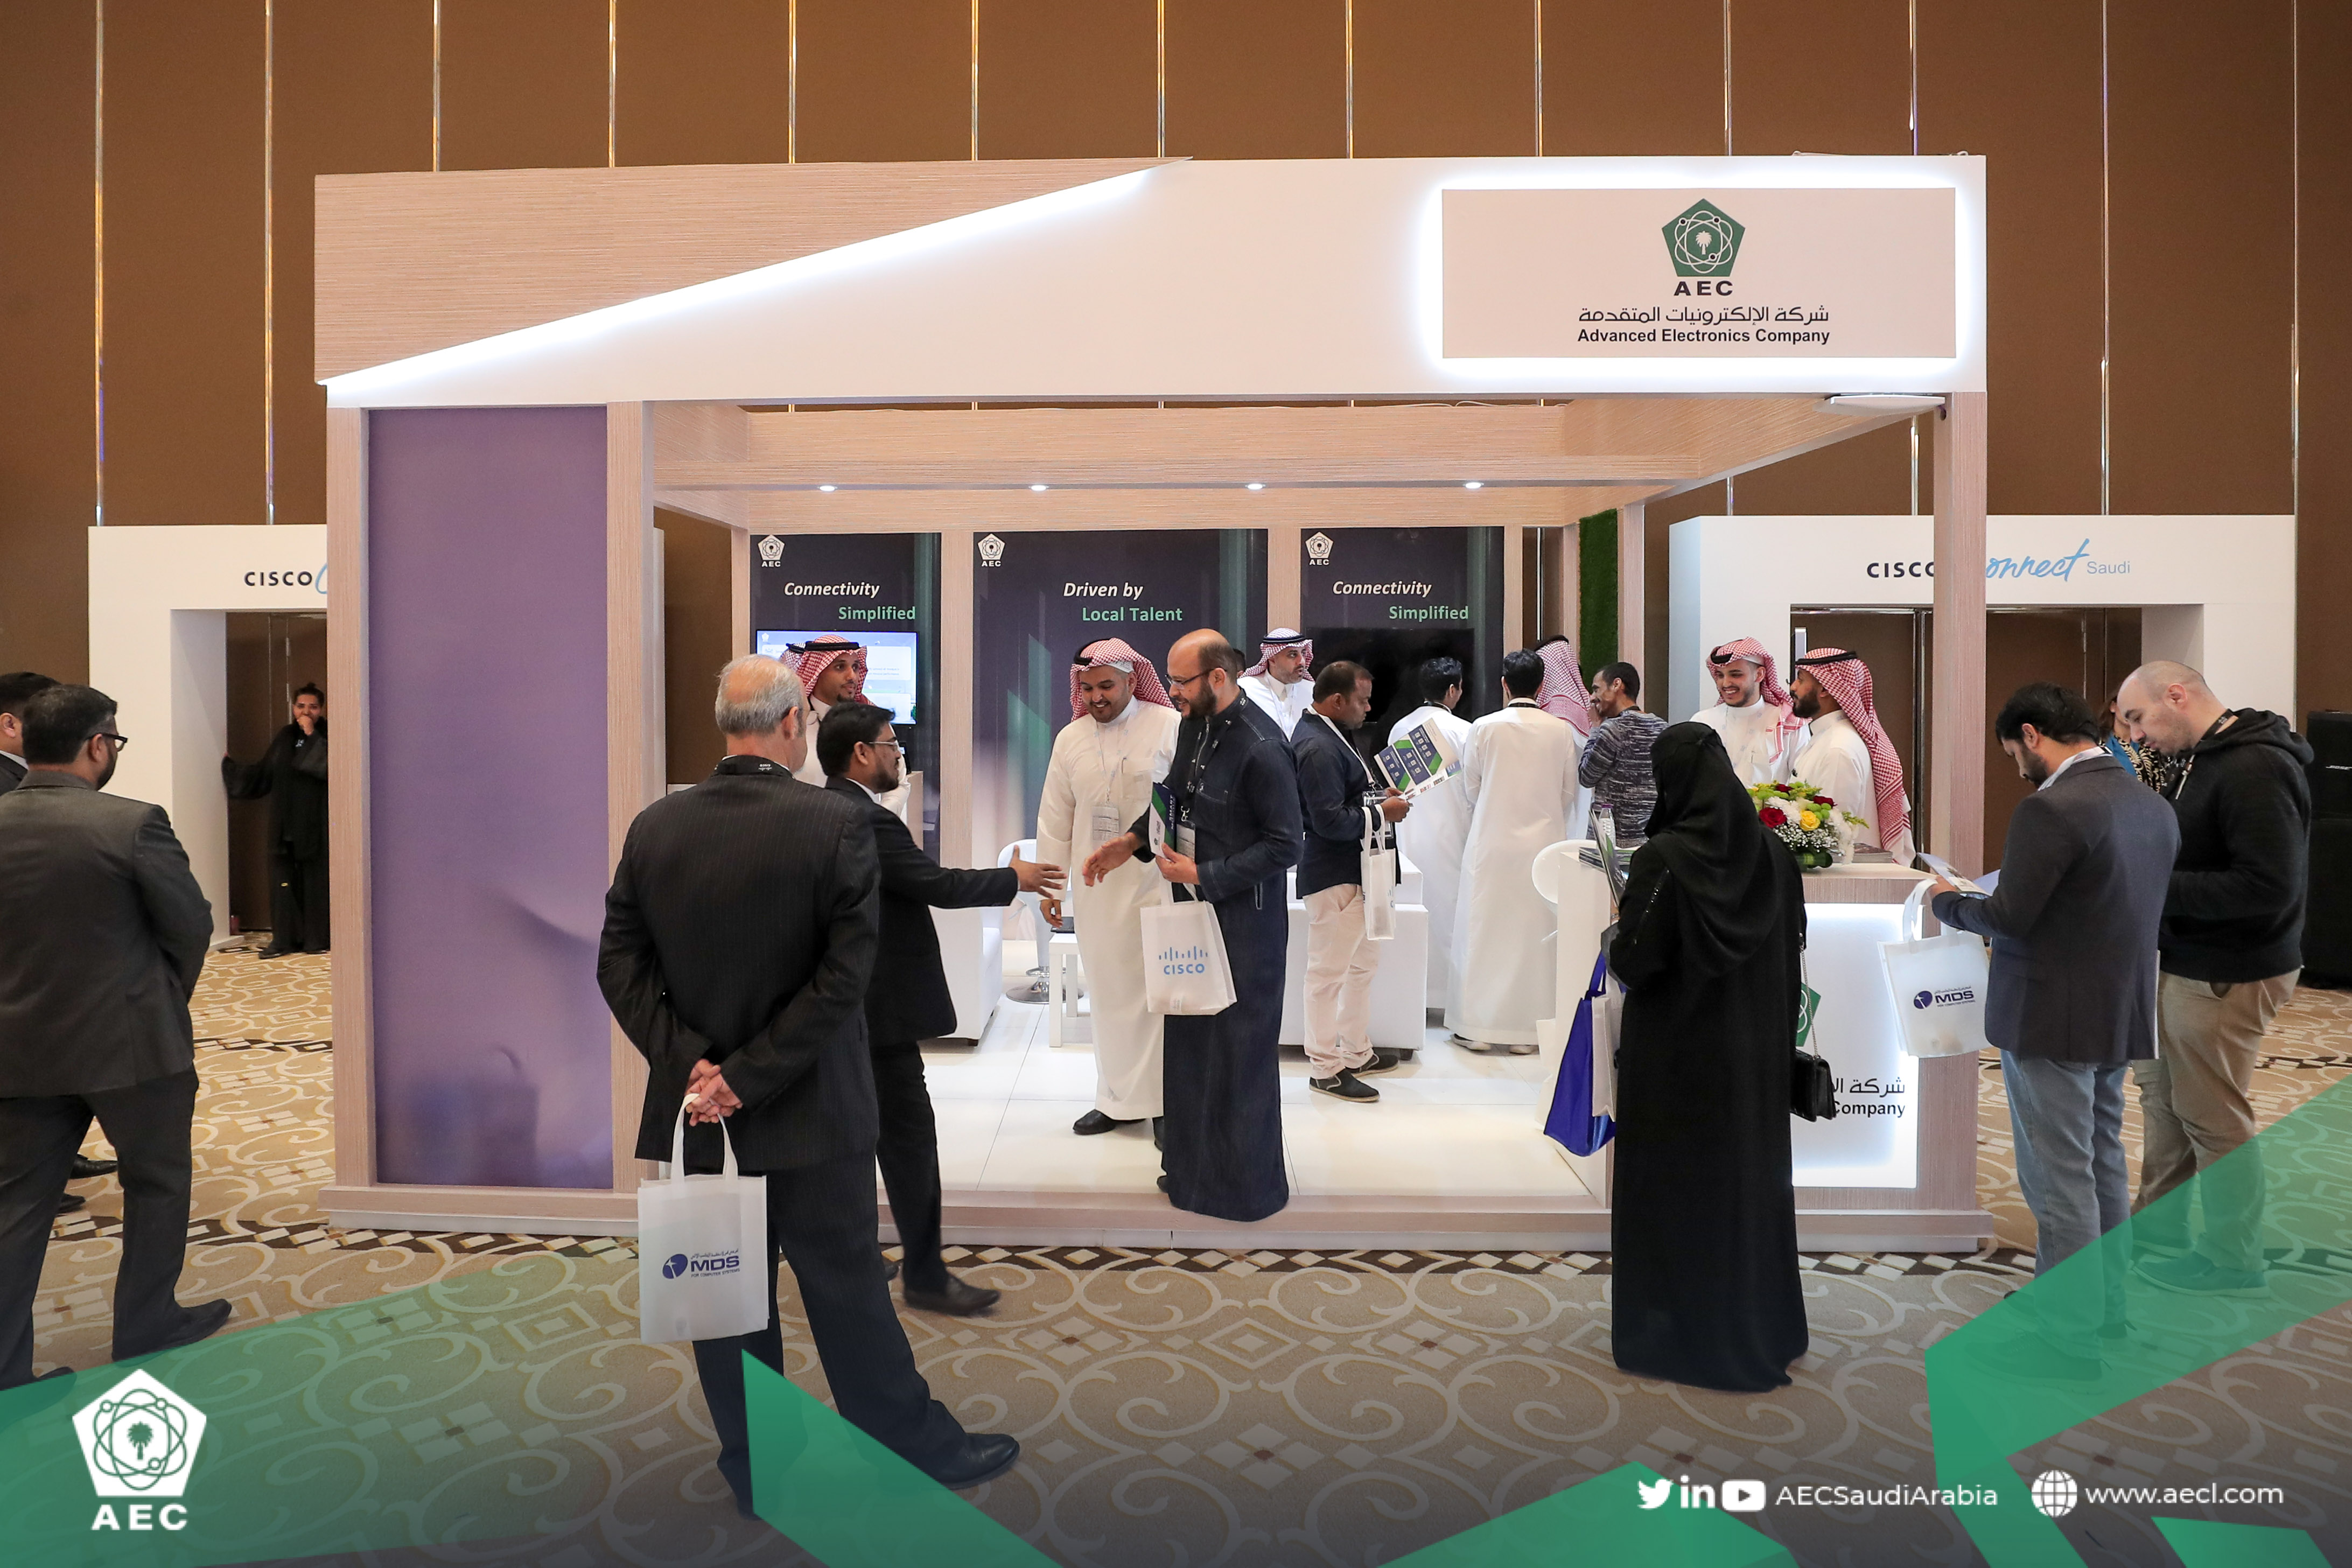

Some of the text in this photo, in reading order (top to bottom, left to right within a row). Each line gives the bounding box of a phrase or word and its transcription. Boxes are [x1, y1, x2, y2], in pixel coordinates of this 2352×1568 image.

[1674, 281, 1733, 296] AEC
[1579, 305, 1829, 325] شركة الإلكترونيات المتقدمة
[1578, 329, 1830, 345] Advanced Electronics Company
[2087, 561, 2130, 575] Saudi
[244, 571, 313, 586] CISCO
[784, 582, 880, 599] Connectivity
[1063, 582, 1144, 601] Driven by
[1332, 580, 1432, 598] Connectivity
[838, 605, 916, 622] Simplified
[1082, 607, 1182, 621] Local Talent
[1389, 605, 1469, 622] Simplified
[1163, 963, 1205, 975] CISCO
[1935, 990, 1974, 1003] MDS
[1850, 1076, 1905, 1098] شركة
[691, 1255, 739, 1272] MDS
